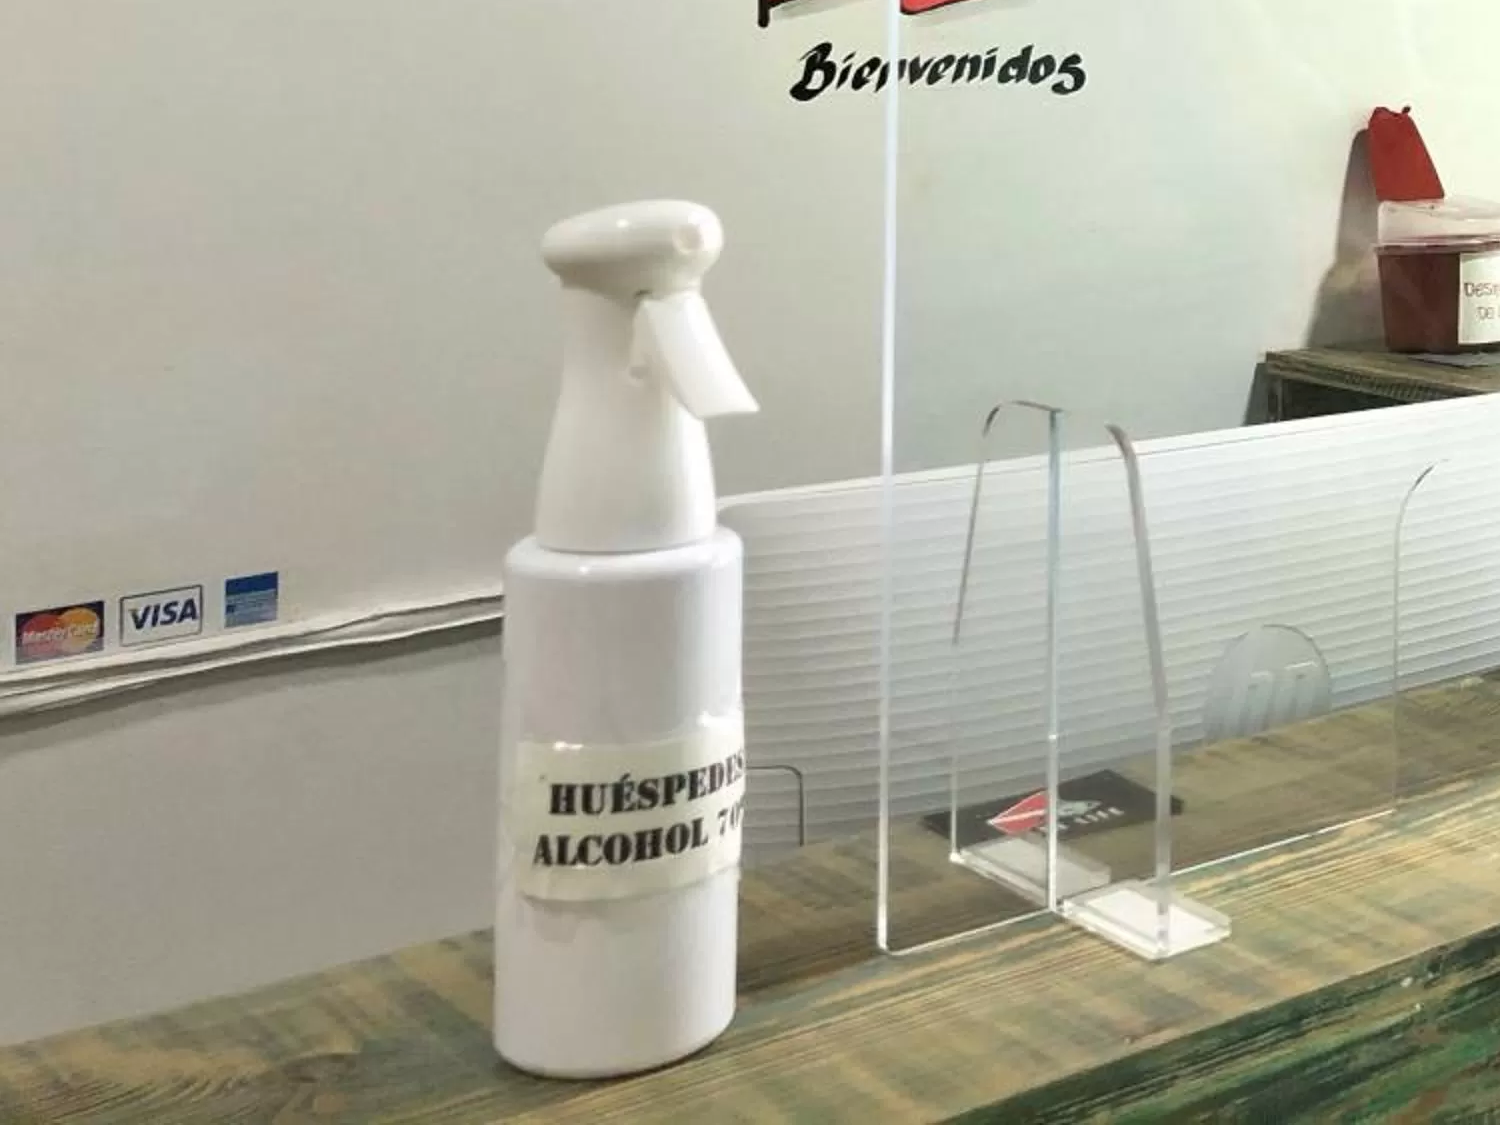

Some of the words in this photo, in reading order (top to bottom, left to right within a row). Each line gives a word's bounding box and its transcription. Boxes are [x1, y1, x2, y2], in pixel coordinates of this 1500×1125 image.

[789, 42, 1087, 102] Bienvenidos
[129, 598, 197, 630] VISA
[533, 817, 709, 867] ALCOHOL
